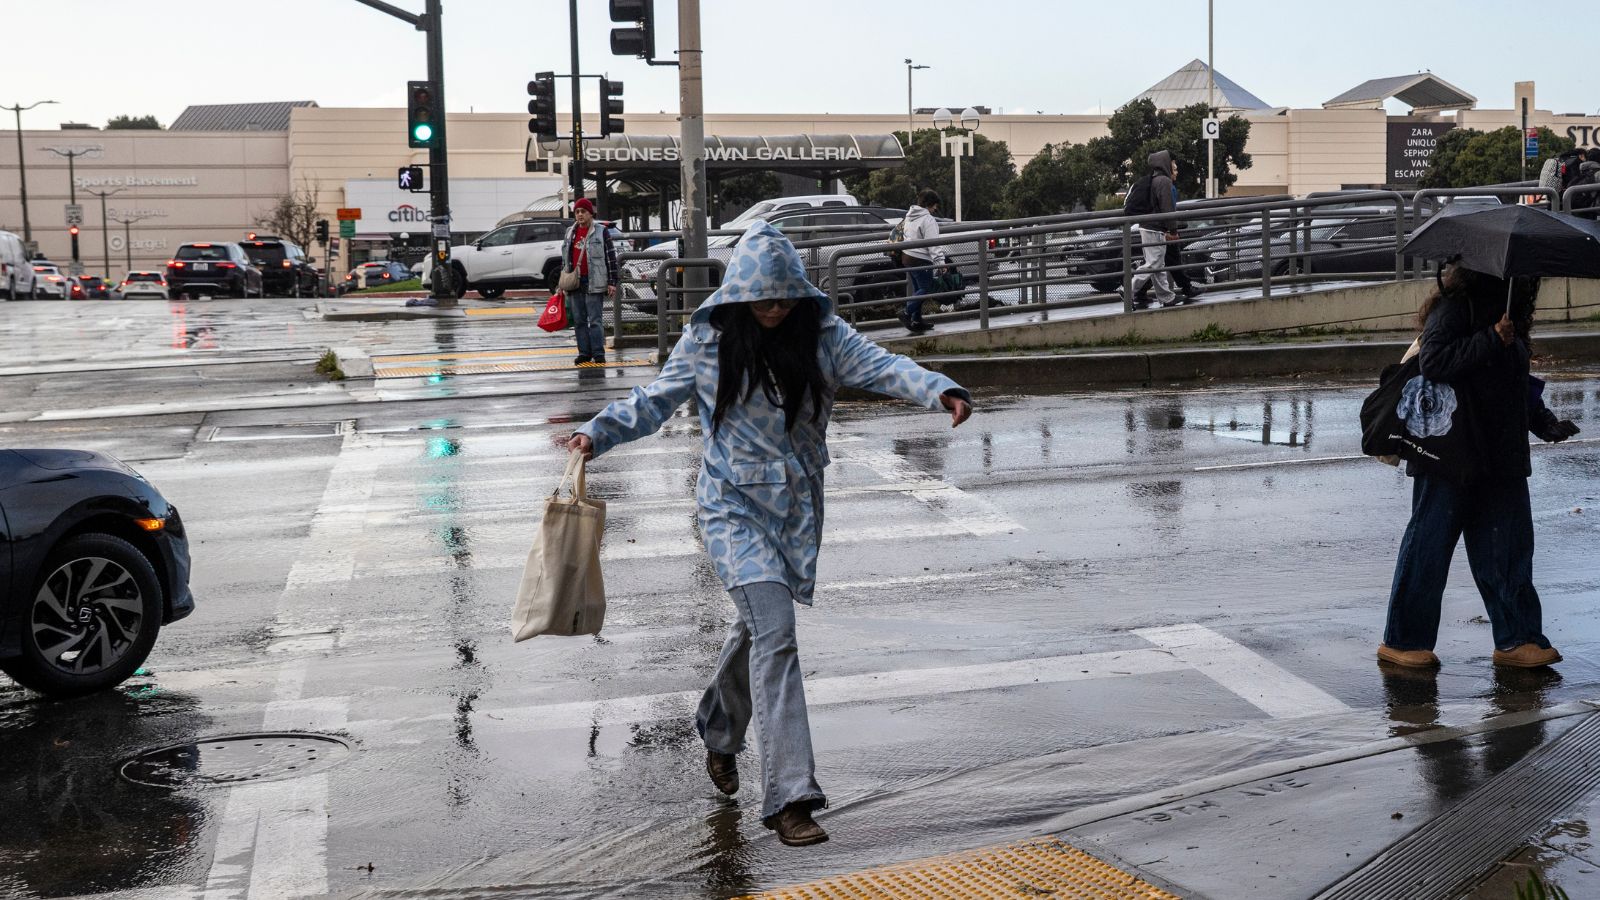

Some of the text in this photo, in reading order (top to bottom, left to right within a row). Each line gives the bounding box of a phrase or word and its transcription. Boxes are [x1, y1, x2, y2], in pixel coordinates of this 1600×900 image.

[1206, 121, 1217, 135] C
[1411, 128, 1433, 136] ZARA
[1407, 138, 1437, 147] UNIQLO
[585, 146, 862, 161] STONESWN GALLERIA
[1403, 149, 1434, 157] SEPHO
[1411, 159, 1432, 168] VAN
[73, 175, 199, 188] Sports Basement
[388, 206, 454, 223] citiba
[68, 215, 82, 224] 25
